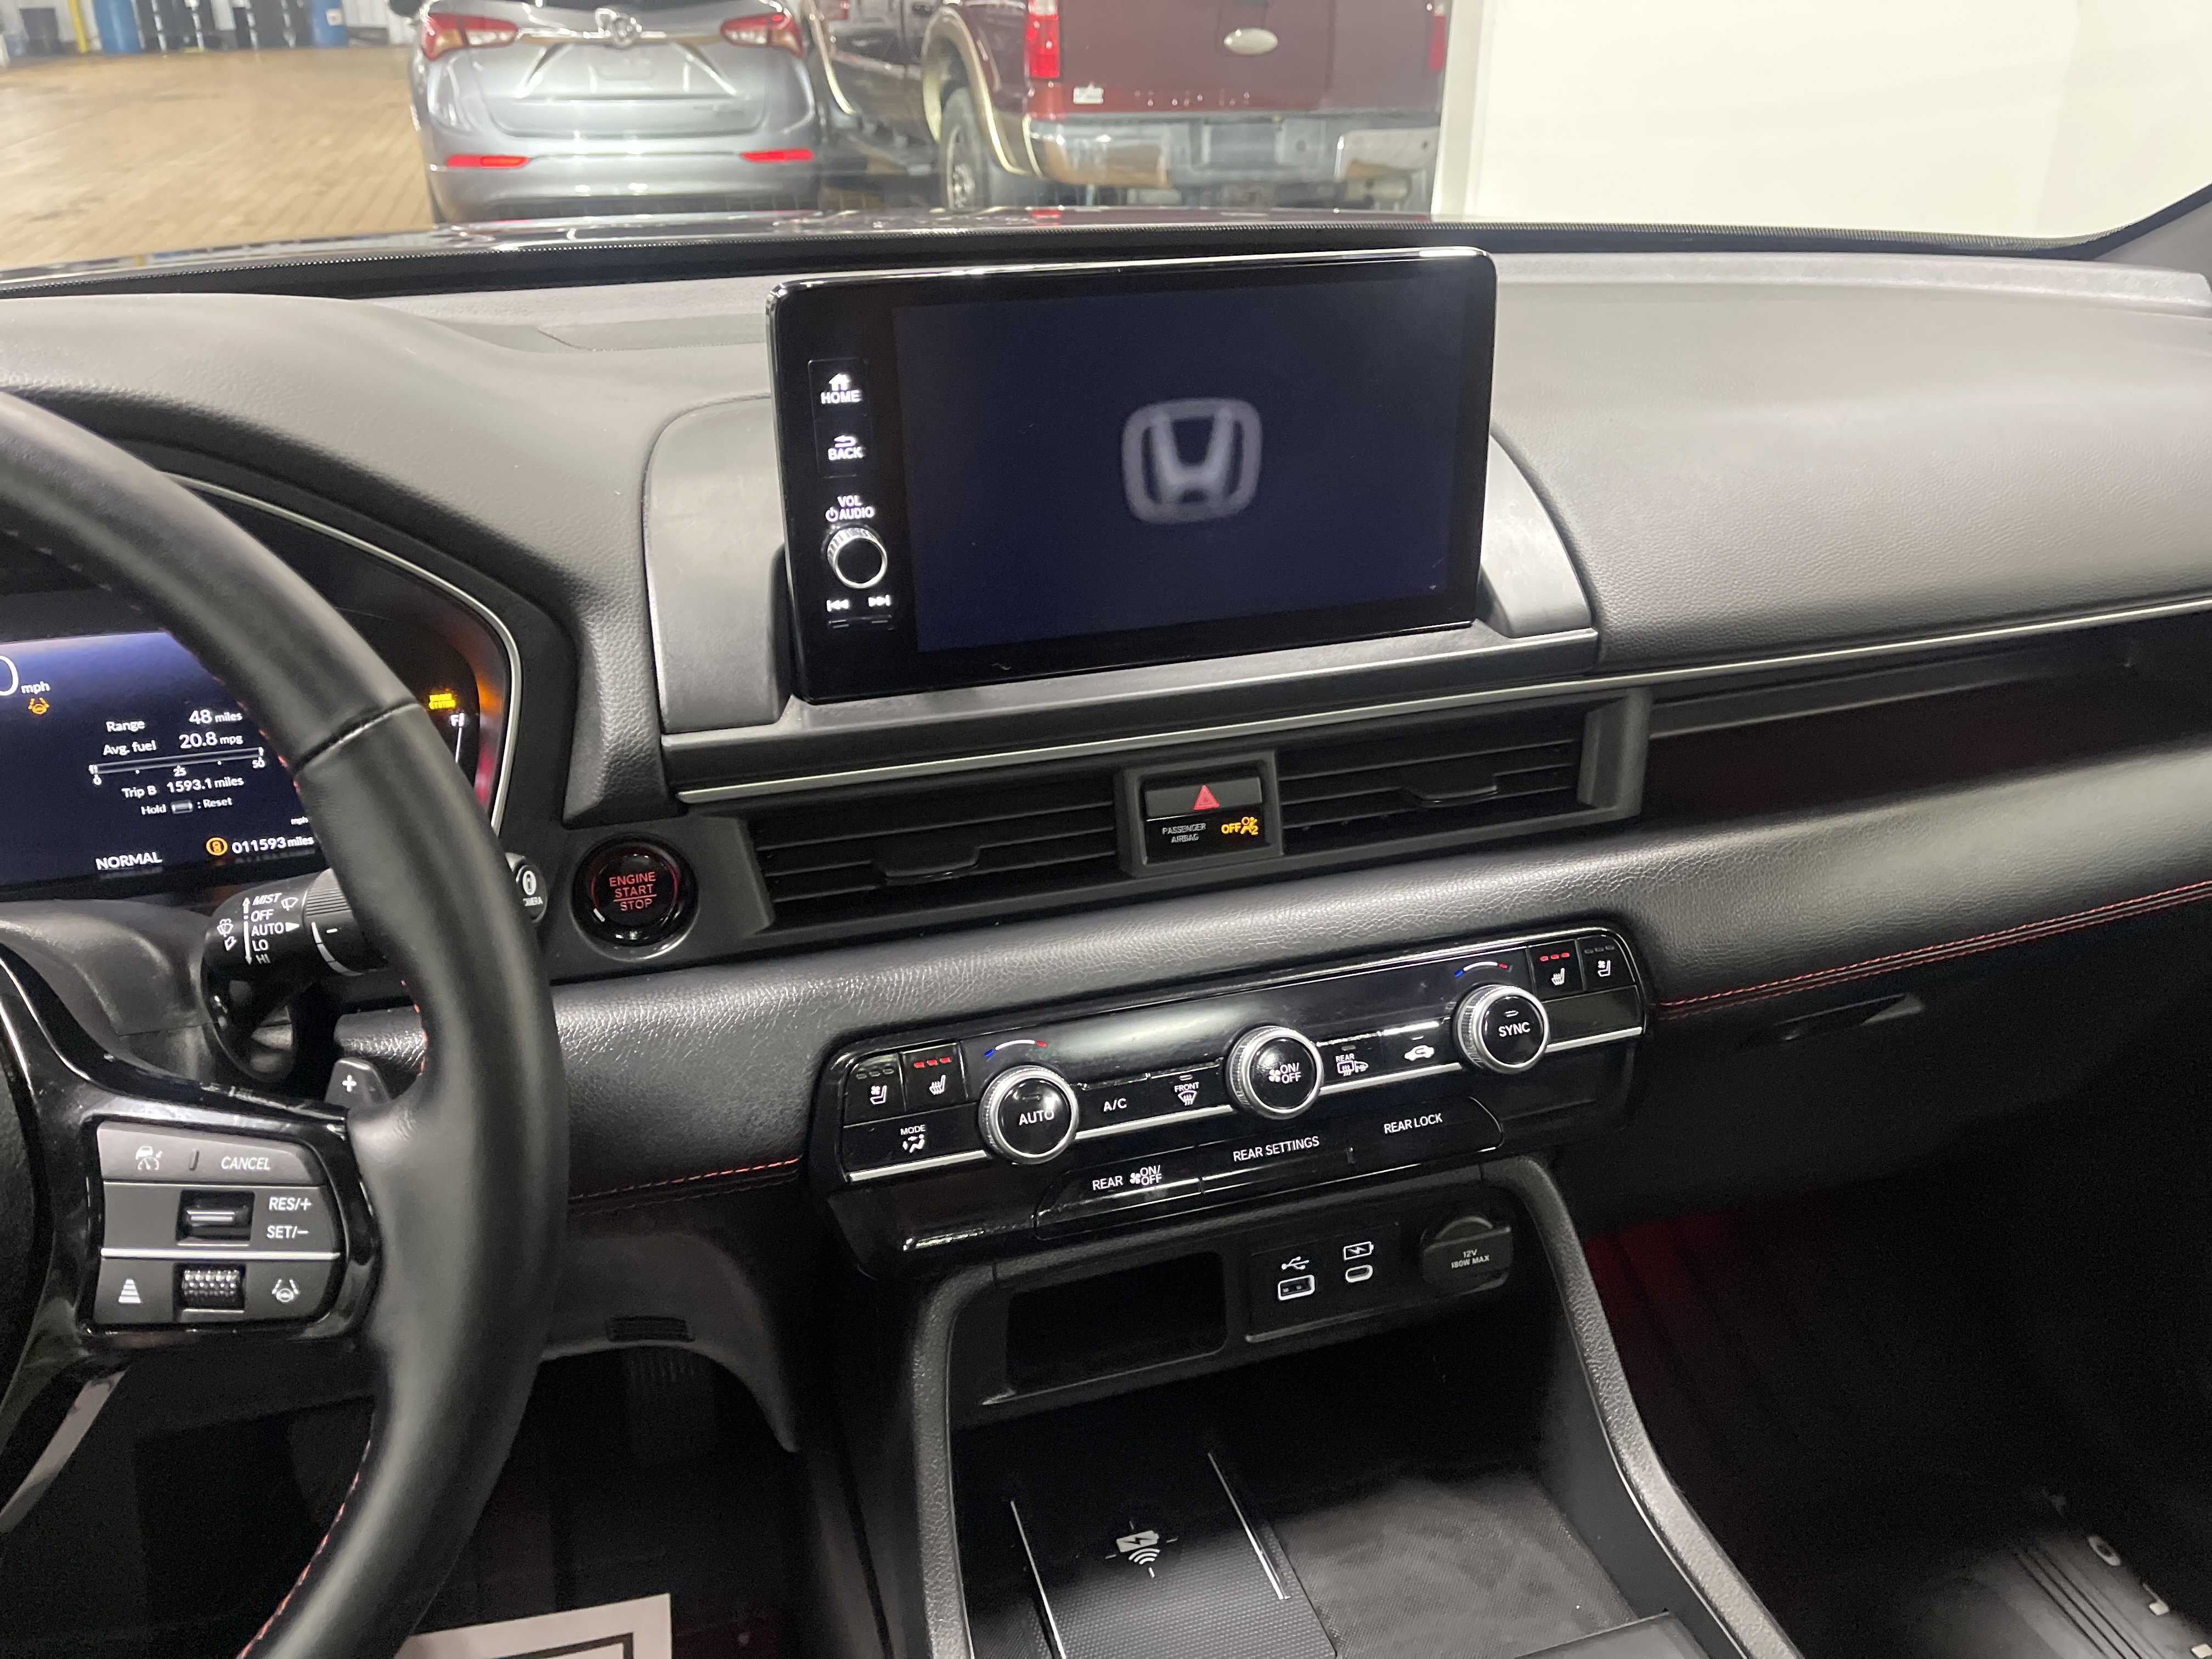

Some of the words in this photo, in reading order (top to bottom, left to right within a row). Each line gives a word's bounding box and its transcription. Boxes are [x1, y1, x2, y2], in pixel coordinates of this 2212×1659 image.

[821, 390, 861, 404] HOME
[828, 447, 864, 460] BACK
[837, 495, 862, 507] VOL
[839, 506, 875, 520] AUDIO
[21, 681, 50, 695] mph
[106, 720, 145, 732] Range
[189, 709, 213, 725] 48
[215, 712, 242, 723] miles
[103, 744, 130, 755] Avg.
[132, 740, 157, 752] fuel
[179, 731, 218, 749] 20.8
[219, 735, 244, 746] mpg
[93, 777, 102, 785] 0
[173, 767, 187, 777] 25
[252, 759, 265, 769] 50
[121, 787, 145, 799] Trip
[147, 785, 157, 795] B
[167, 778, 212, 793] 1593.1
[214, 777, 245, 788] miles
[141, 804, 167, 815] Hold
[203, 797, 233, 809] Reset
[291, 816, 309, 825] mph
[1161, 823, 1206, 835] PASSENGER
[1221, 822, 1242, 834] OFF
[1171, 833, 1199, 843] AIRBAG
[232, 837, 286, 854] 011593
[287, 837, 314, 847] miles
[95, 851, 163, 870] NORMAL
[609, 871, 656, 887] ENGINE
[615, 884, 653, 898] START
[252, 893, 282, 906] MIST
[620, 898, 653, 911] STOP
[250, 909, 274, 922] OFF
[251, 922, 284, 936] AUTO
[252, 939, 269, 952] LO
[256, 954, 270, 964] HI
[1498, 1022, 1531, 1037] SYNC
[1335, 1053, 1355, 1062] REAR
[1280, 1062, 1300, 1073] ON/
[1281, 1071, 1302, 1084] OFF
[1175, 1081, 1200, 1093] FRONT
[1103, 1097, 1127, 1112] A/C
[1018, 1109, 1054, 1126] AUTO
[1384, 1119, 1413, 1134] REAR
[1414, 1113, 1443, 1127] LOCK
[900, 1124, 926, 1136] MODE
[1233, 1147, 1263, 1162] REAR
[1265, 1136, 1320, 1156] SETTINGS
[221, 1156, 272, 1170] CANCEL
[1140, 1165, 1161, 1176] ON/
[1092, 1175, 1124, 1190] REAR
[1142, 1173, 1163, 1186] OFF
[1463, 1249, 1477, 1258] 12V
[1451, 1259, 1470, 1269] 180W
[1472, 1255, 1490, 1264] MAX
